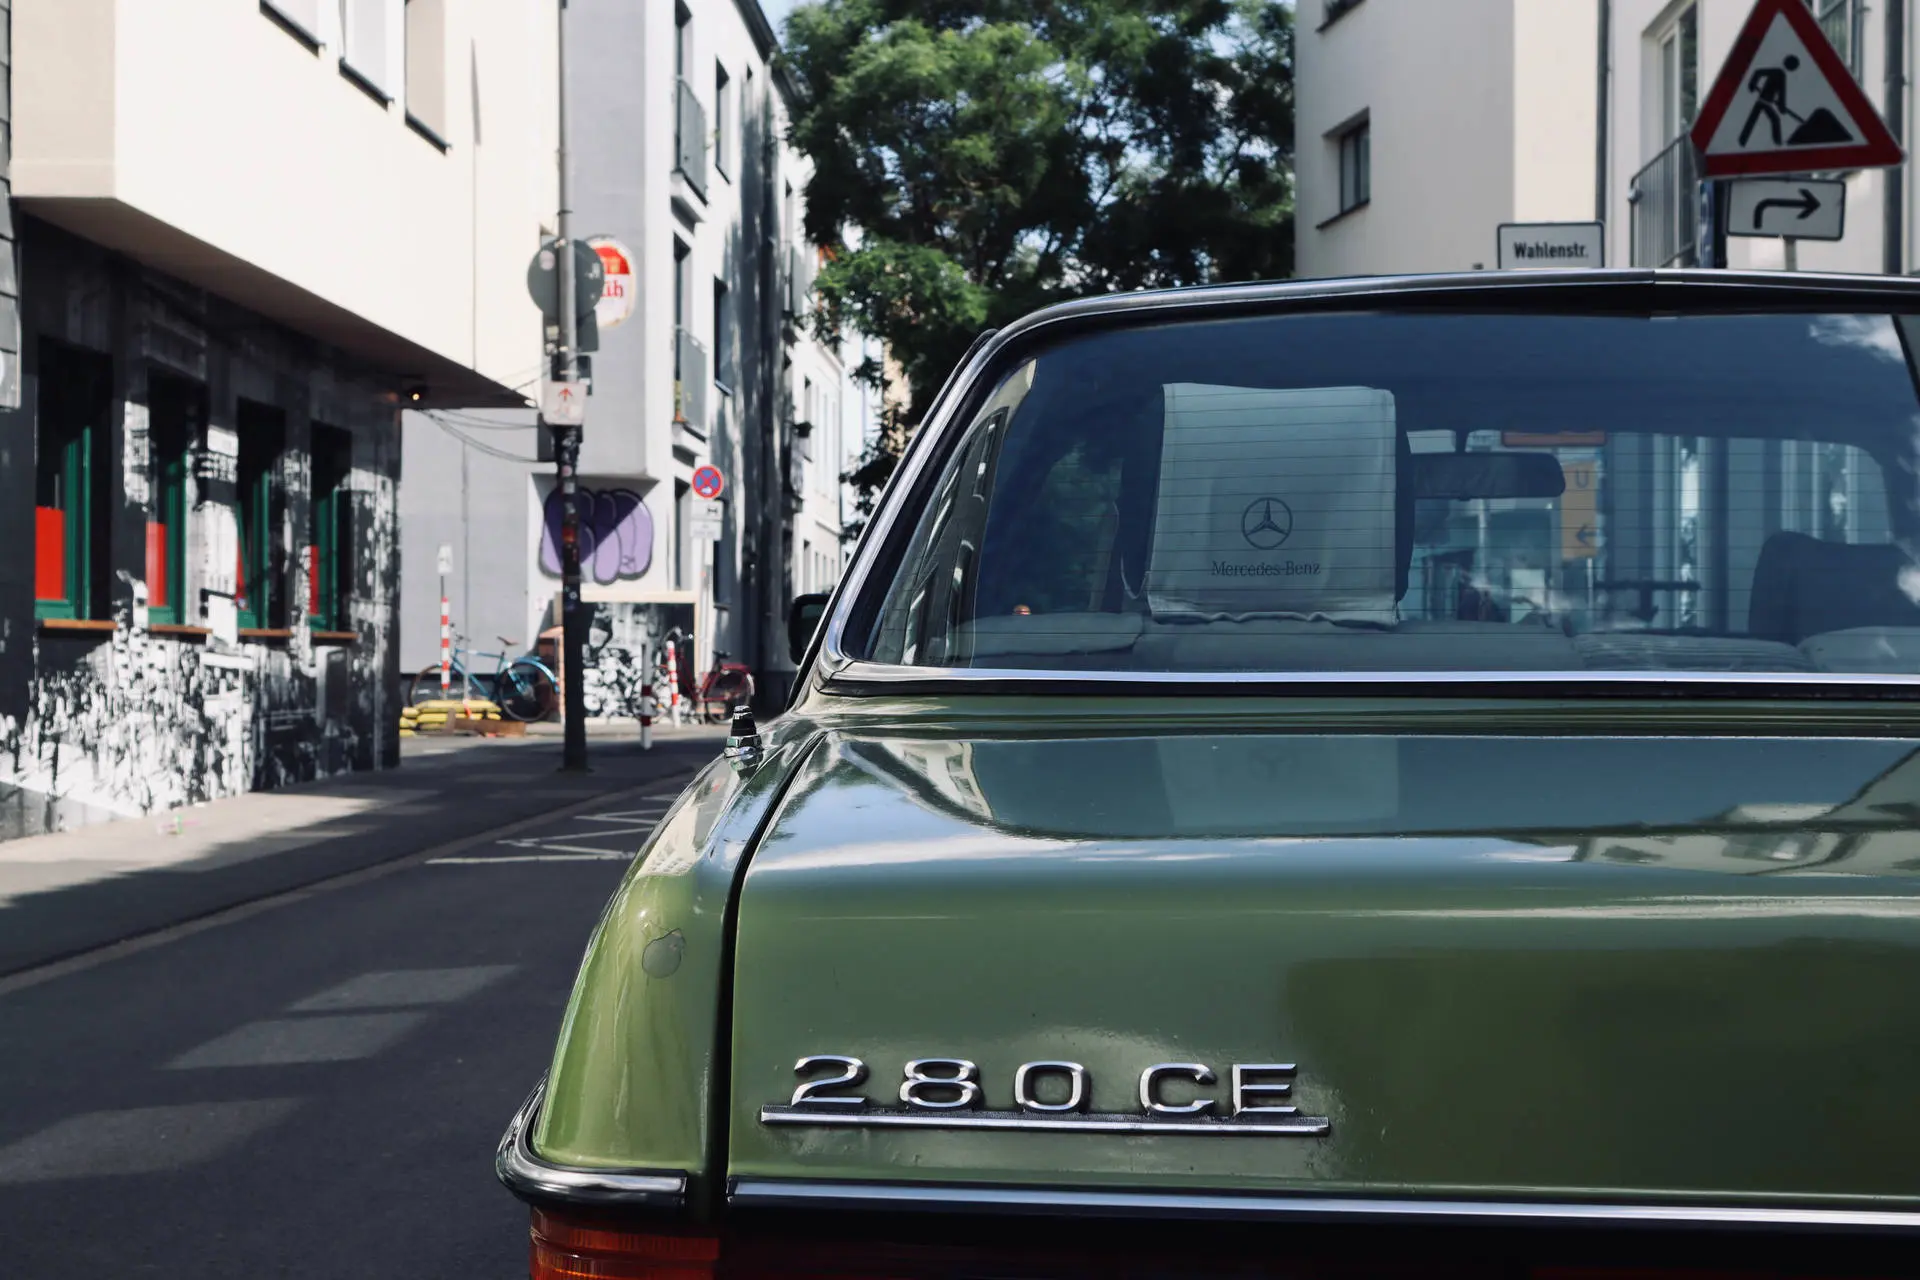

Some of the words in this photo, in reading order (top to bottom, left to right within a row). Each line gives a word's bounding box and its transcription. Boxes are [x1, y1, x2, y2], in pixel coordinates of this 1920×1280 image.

[1513, 242, 1589, 259] Wahlenstr.
[1575, 469, 1589, 490] U
[1211, 560, 1321, 577] Mercedes-Benz
[792, 1054, 1088, 1113] 280
[1138, 1062, 1298, 1116] CE
